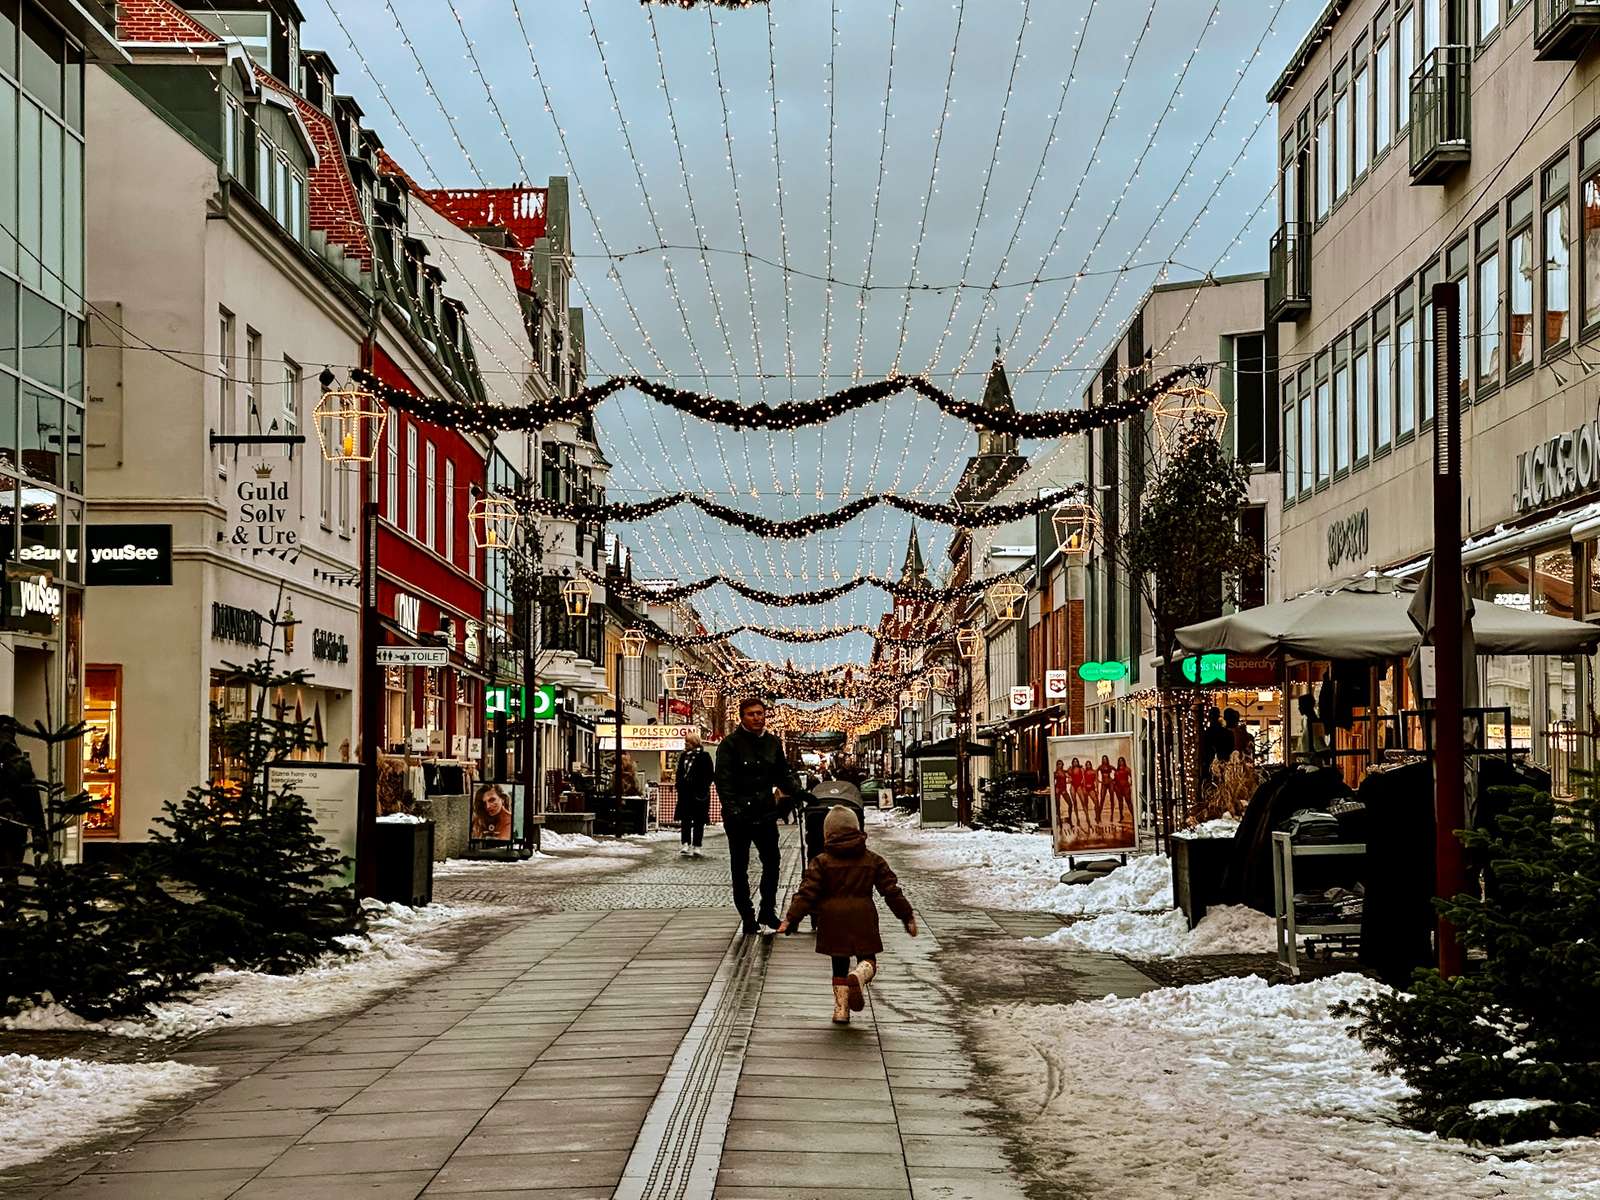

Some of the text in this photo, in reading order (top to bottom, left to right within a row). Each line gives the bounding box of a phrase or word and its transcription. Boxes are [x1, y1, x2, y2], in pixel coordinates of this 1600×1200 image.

[237, 481, 289, 501] Guld
[240, 503, 287, 524] Sølv
[231, 525, 297, 545] & Ure
[91, 544, 159, 563] youSee
[20, 575, 61, 618] youSee
[411, 652, 445, 662] TOILET
[1227, 658, 1275, 671] Superdry
